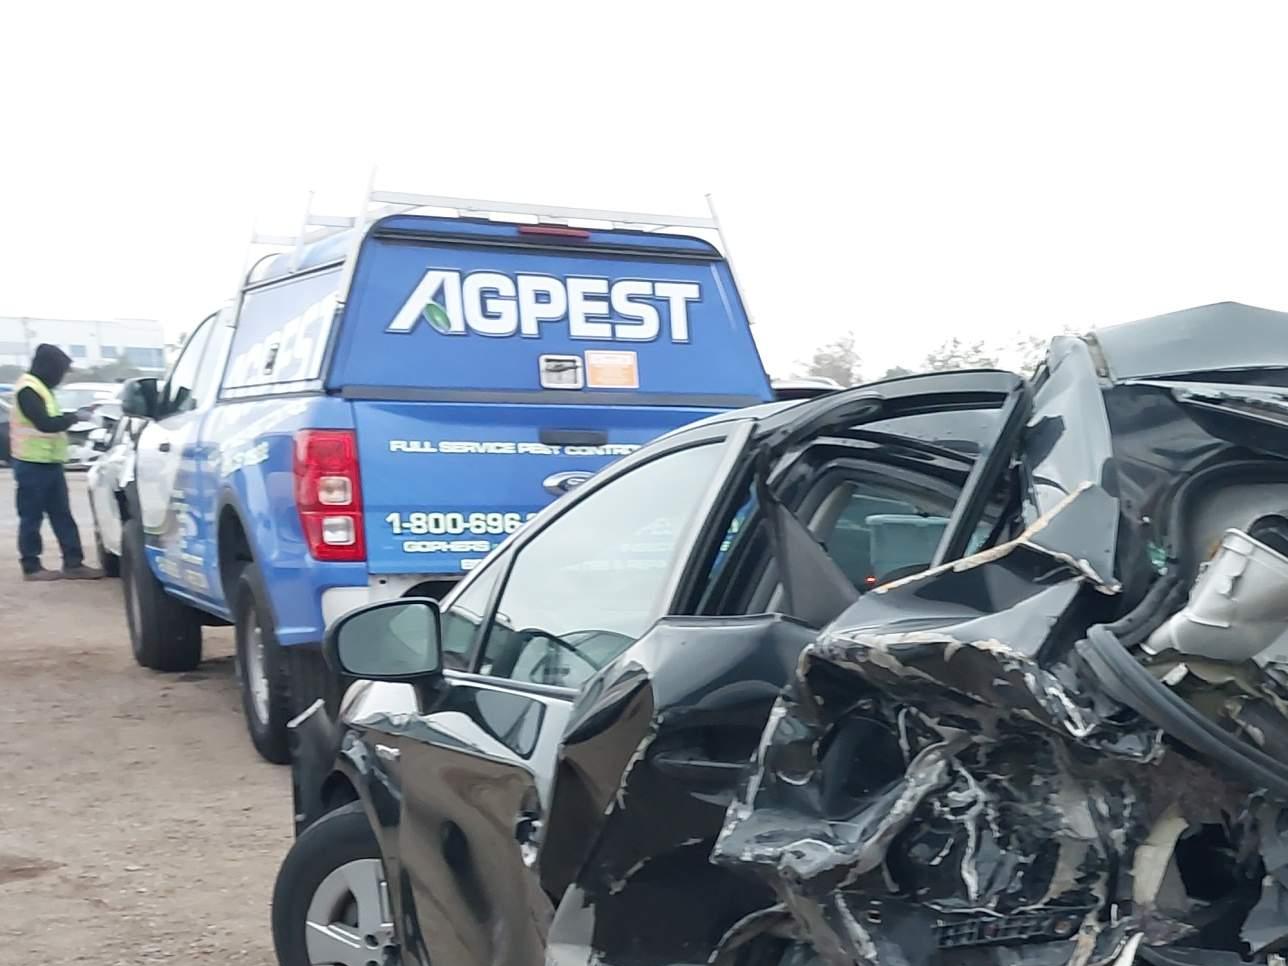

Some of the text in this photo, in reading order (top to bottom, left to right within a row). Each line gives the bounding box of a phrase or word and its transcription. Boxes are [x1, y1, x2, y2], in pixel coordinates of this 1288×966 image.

[385, 267, 702, 343] AGPEST
[389, 439, 438, 453] FULL
[438, 441, 516, 454] SERVICE
[517, 442, 562, 456] PEST
[385, 512, 542, 534] 1-800-696-
[403, 541, 490, 552] GOPHERS
